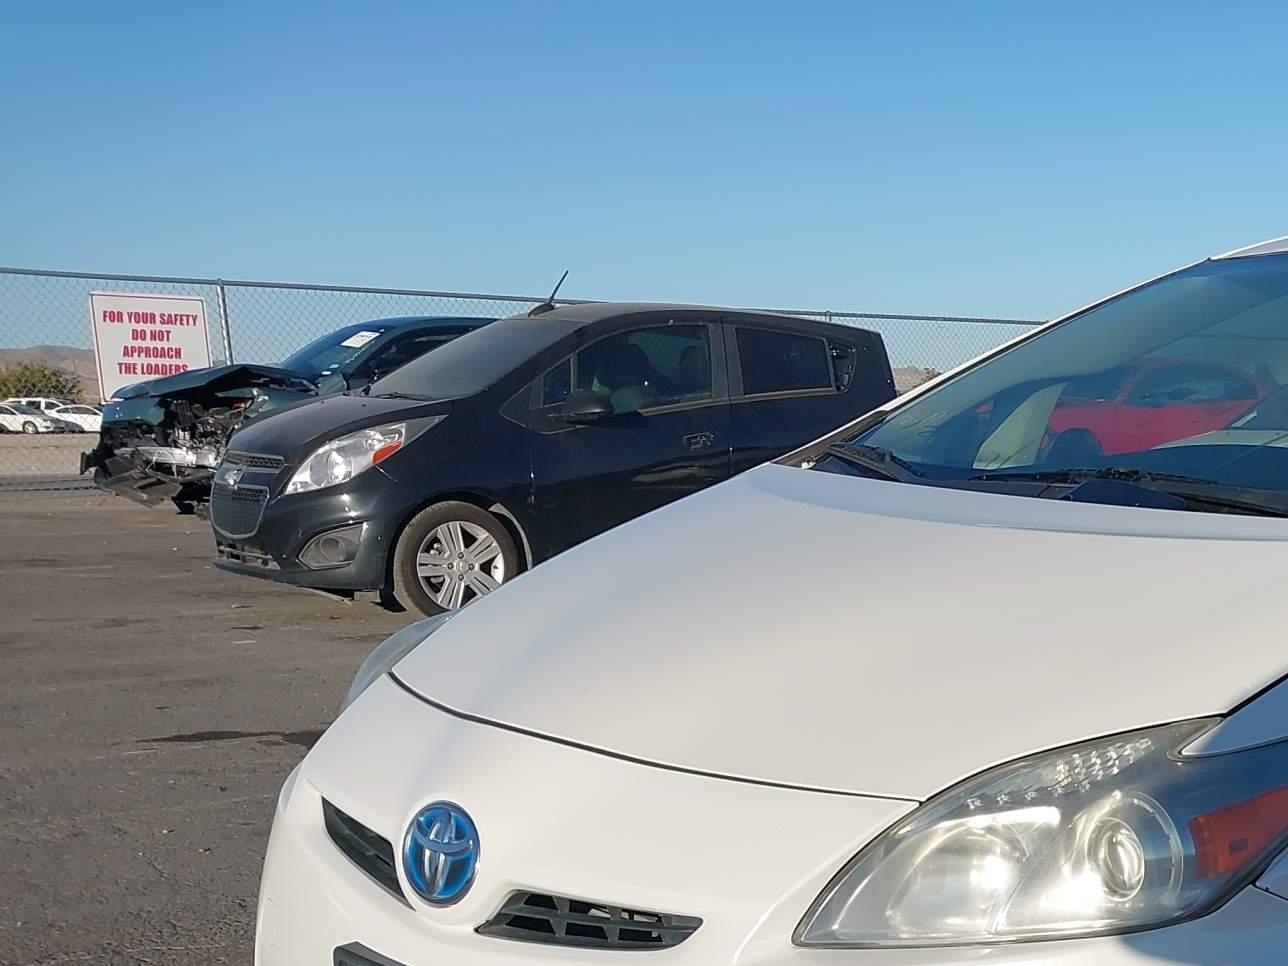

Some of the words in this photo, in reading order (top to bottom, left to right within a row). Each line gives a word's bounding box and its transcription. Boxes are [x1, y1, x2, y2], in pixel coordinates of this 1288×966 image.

[102, 310, 123, 323] FOR
[127, 311, 157, 324] YOUR
[159, 313, 198, 326] SAFETY
[131, 328, 147, 341] DO
[150, 329, 171, 342] NOT
[122, 345, 182, 359] APPROACH
[117, 362, 138, 375] THE
